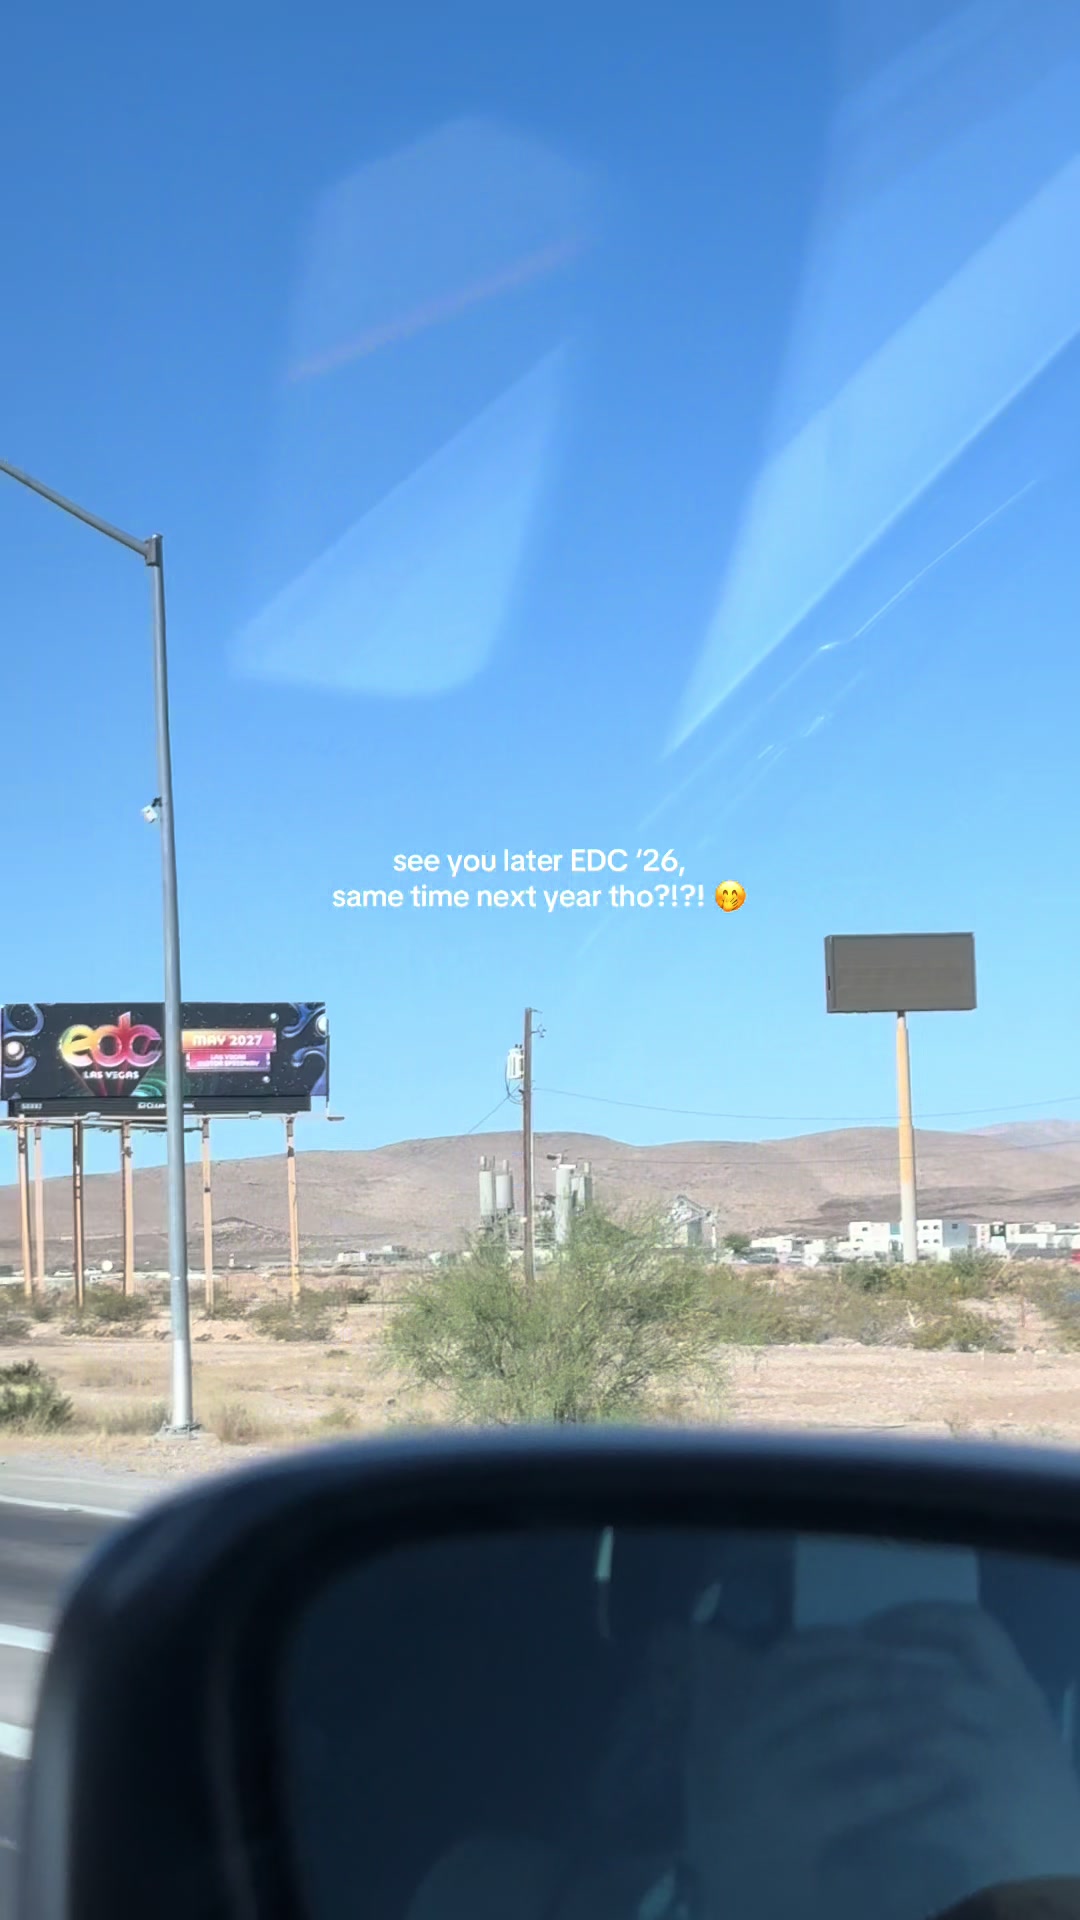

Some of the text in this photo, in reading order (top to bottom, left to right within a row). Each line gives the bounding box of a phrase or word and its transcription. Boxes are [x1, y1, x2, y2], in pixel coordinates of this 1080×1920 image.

[192, 1034, 263, 1046] MAY 2027
[83, 1071, 140, 1079] LAS VEGAS
